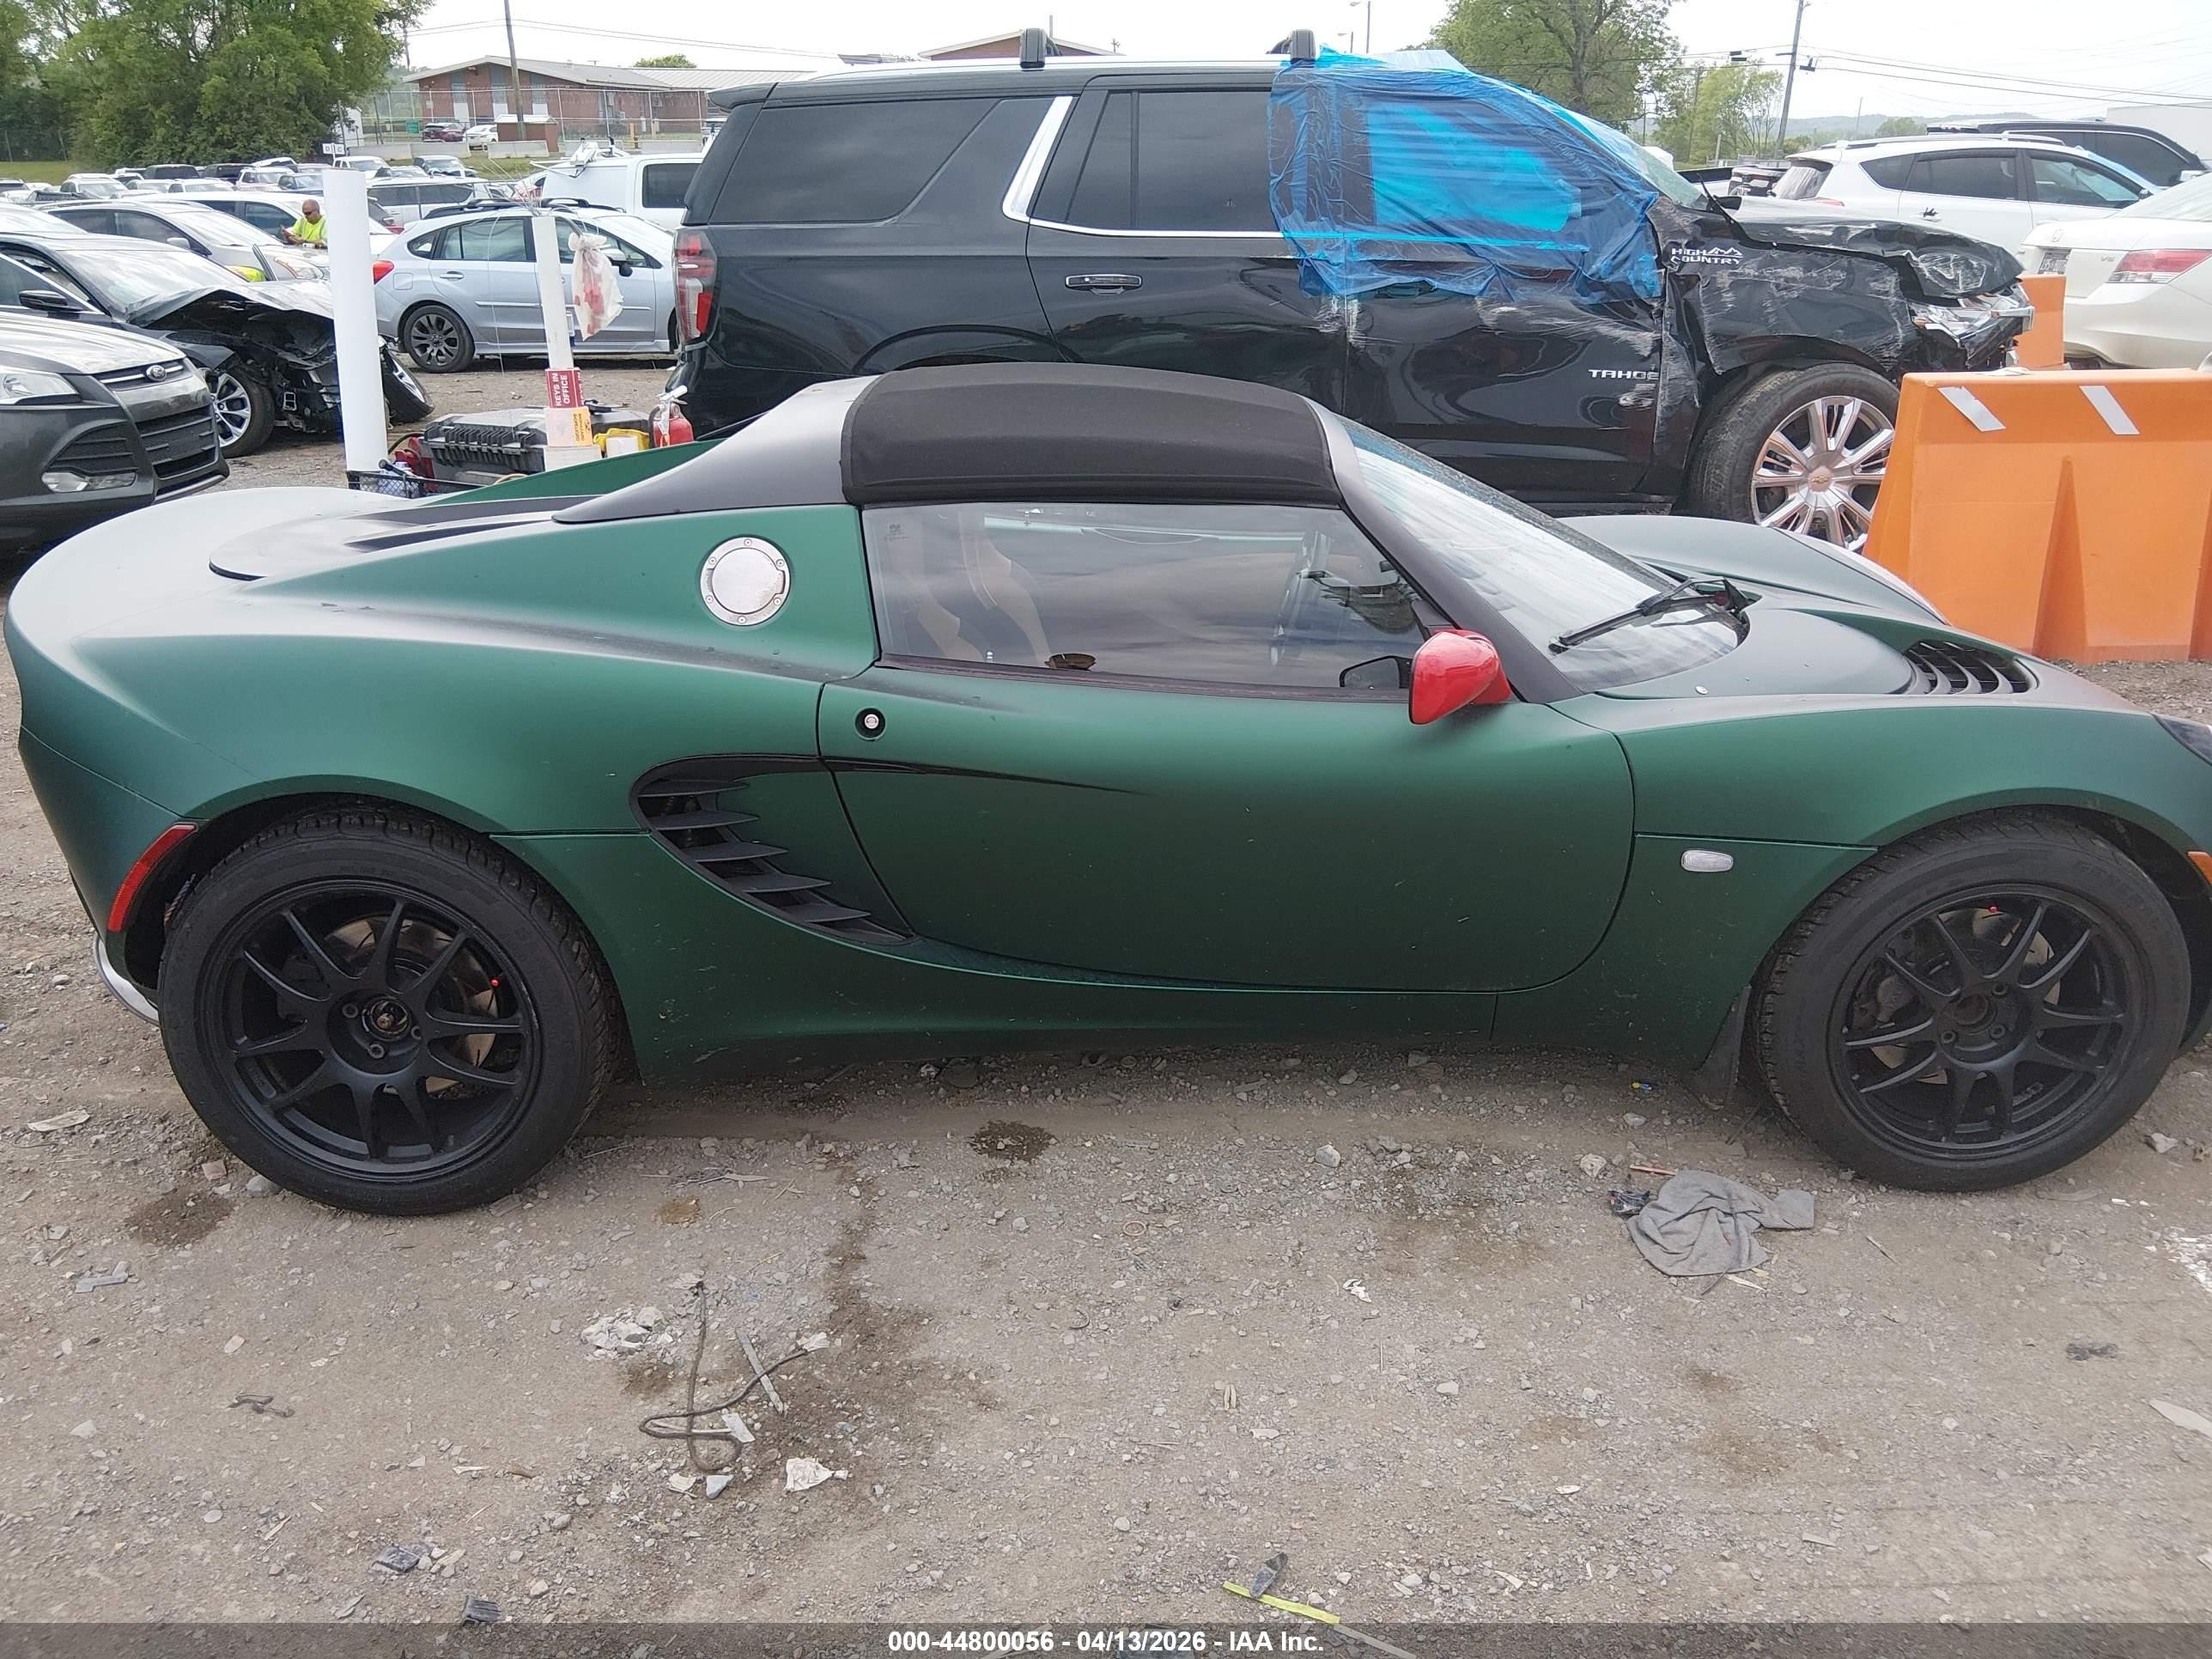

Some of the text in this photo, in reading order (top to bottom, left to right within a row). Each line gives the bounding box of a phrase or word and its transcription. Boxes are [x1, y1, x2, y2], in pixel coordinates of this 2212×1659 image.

[1670, 255, 1743, 265] COUNTRY
[1588, 368, 1659, 380] TAHOE
[551, 372, 562, 406] KEYS IN
[560, 374, 571, 404] OFFICE
